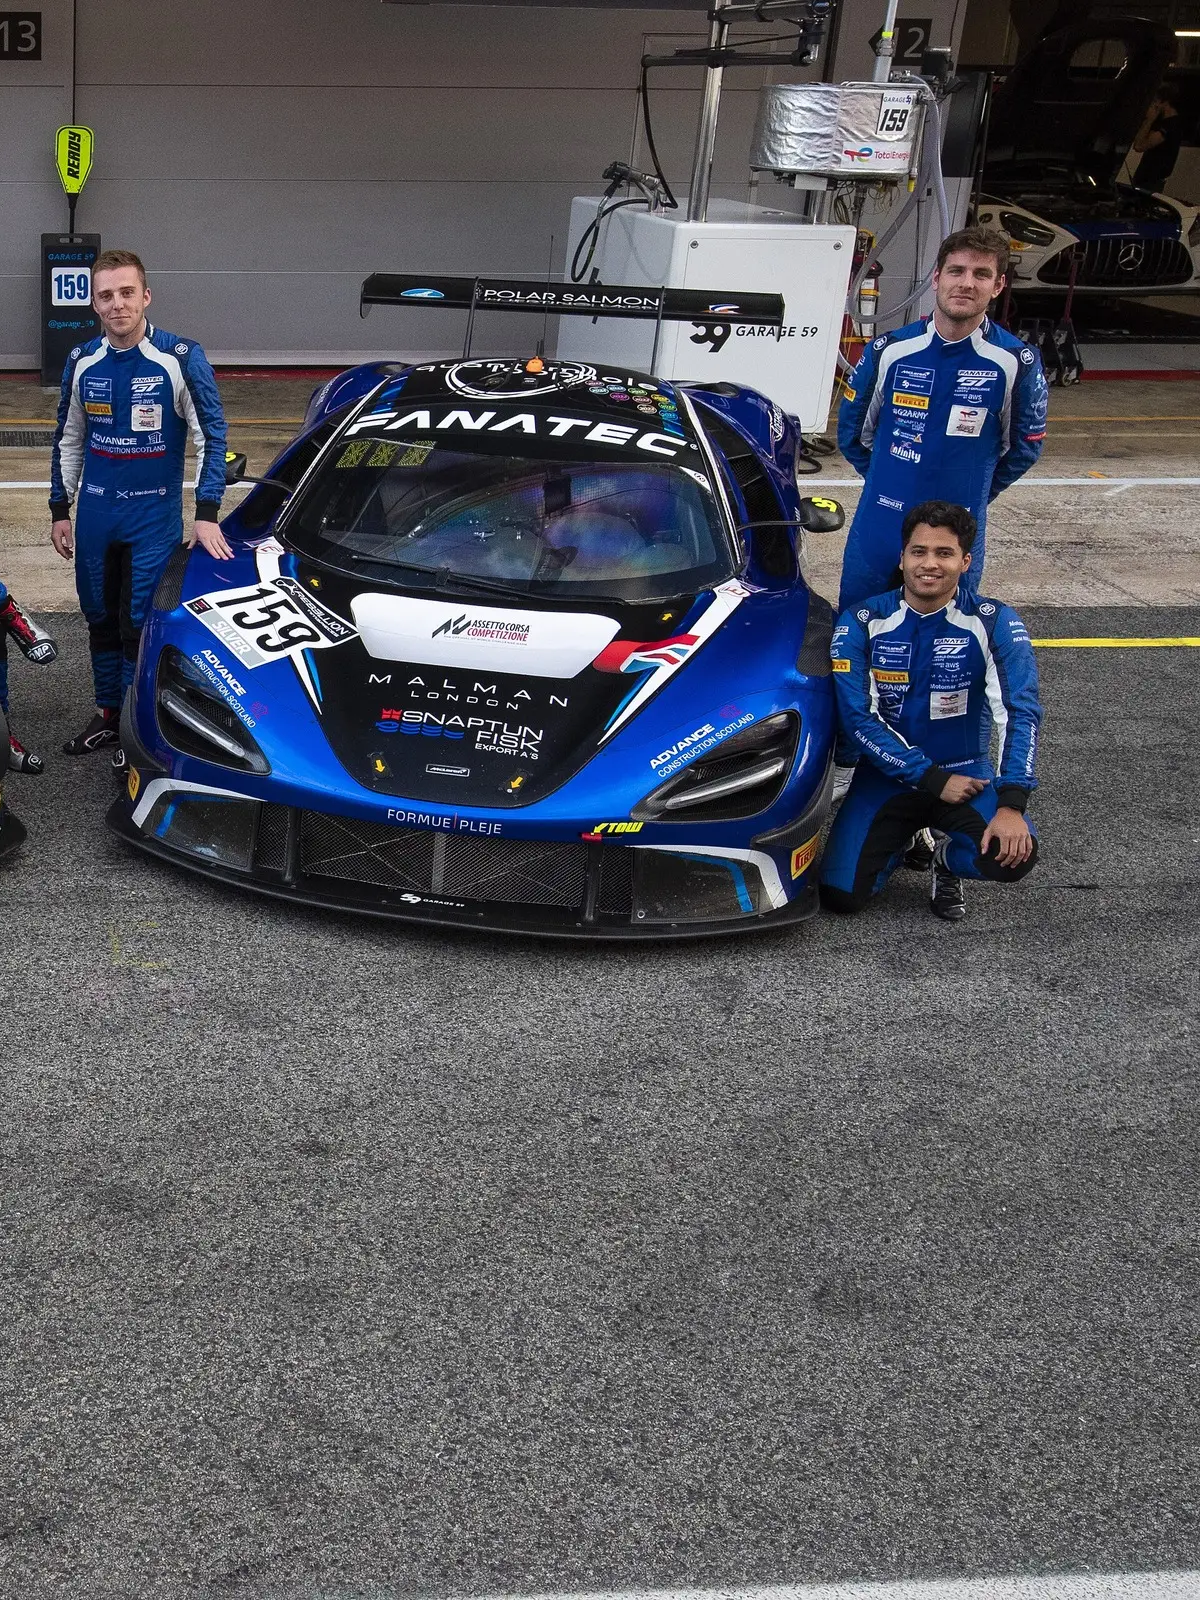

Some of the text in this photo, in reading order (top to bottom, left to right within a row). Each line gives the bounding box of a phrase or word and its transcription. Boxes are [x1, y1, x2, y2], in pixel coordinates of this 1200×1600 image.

[879, 109, 909, 131] 159
[67, 130, 81, 179] READY
[48, 253, 94, 261] GARAGE 59
[54, 273, 89, 300] 159
[484, 289, 659, 307] POLAR SALMON
[736, 326, 796, 337] GARAGE
[801, 326, 818, 337] 59
[895, 395, 926, 406] PIRELLI
[892, 408, 928, 420] #G2ARMY
[92, 432, 137, 445] ADVANCE
[344, 410, 688, 456] FANATEC
[132, 445, 166, 454] SCOTLAND
[215, 587, 321, 653] 159
[471, 620, 530, 633] ASSETTO CORSA
[211, 620, 249, 655] SILVER
[467, 627, 529, 642] COMPETIZIONE
[201, 648, 247, 696] ADVANCE
[191, 654, 256, 729] CONSTRUCTION SCOTLAND
[368, 673, 568, 707] MALMAN
[410, 690, 519, 710] LONDON
[402, 710, 543, 741] SNAPTUN
[474, 742, 519, 757] EXPORT
[476, 730, 540, 753] FISK
[649, 723, 716, 769] ADVANCE
[657, 712, 755, 779] CONSTRUCTION SCOTLAND
[865, 740, 882, 756] REAL
[387, 808, 503, 835] FORMUE PLEJE
[606, 822, 644, 833] TOW
[423, 898, 454, 906] GARAGE
